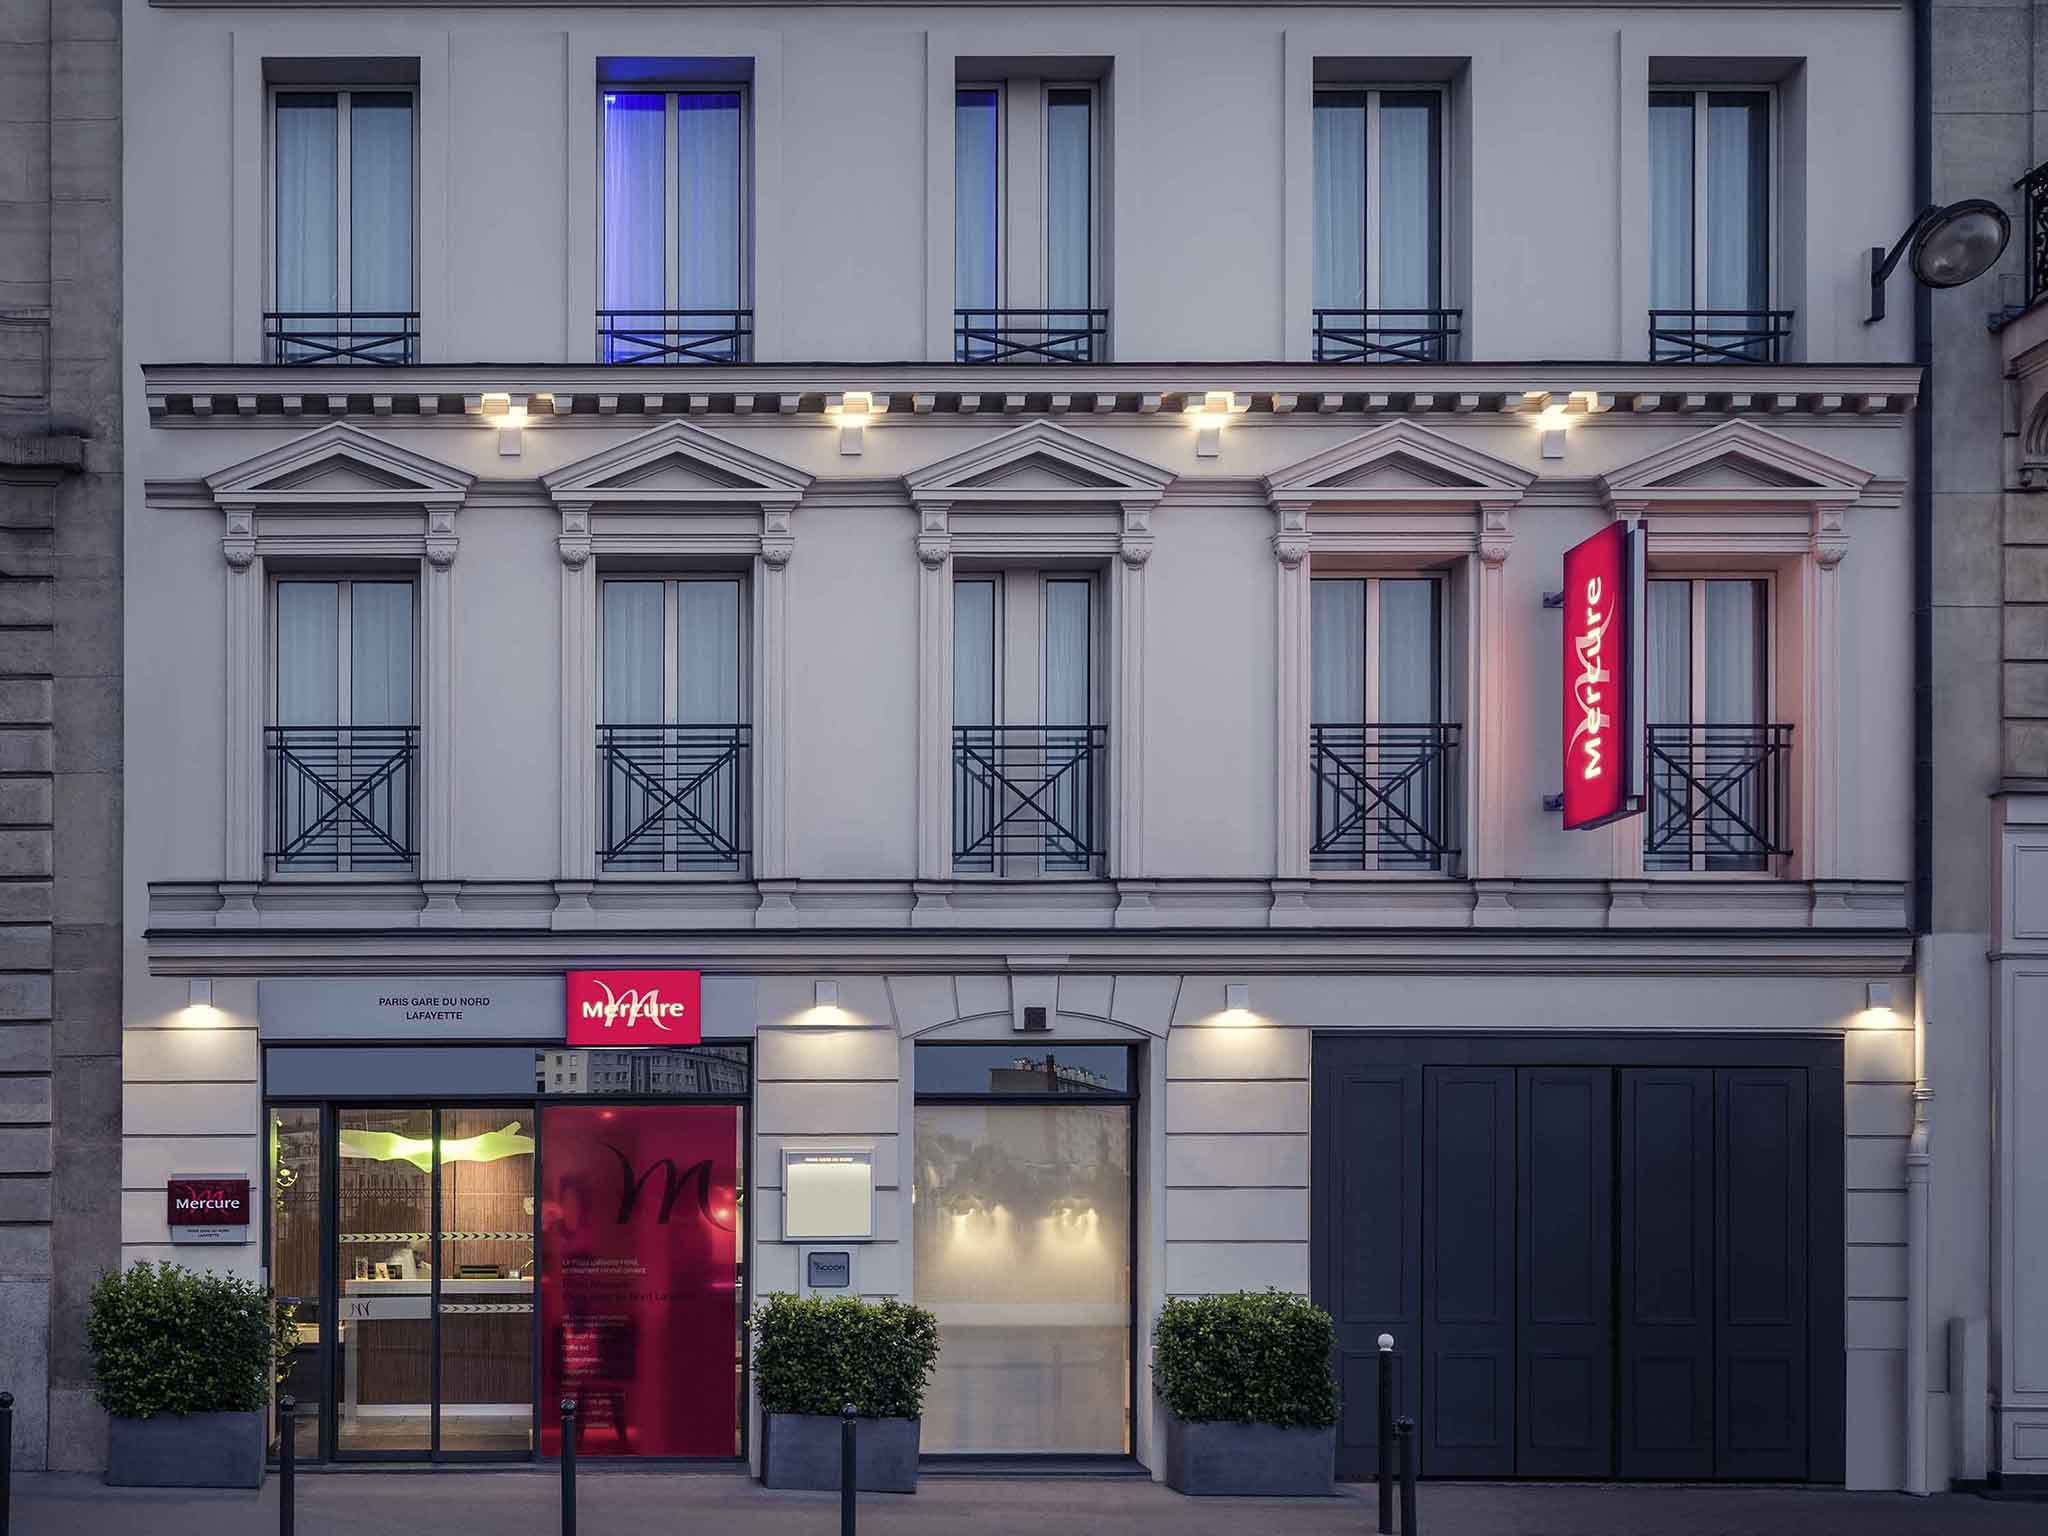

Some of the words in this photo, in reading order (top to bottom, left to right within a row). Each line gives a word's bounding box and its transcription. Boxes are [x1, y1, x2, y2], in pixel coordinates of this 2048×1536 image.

[1583, 576, 1602, 780] Mercure
[379, 997, 409, 1007] PARIS
[411, 997, 440, 1007] GARE
[442, 997, 457, 1007] DU
[460, 997, 490, 1007] NORD
[406, 1011, 463, 1020] LAFAYETTE
[582, 1001, 685, 1019] Mercure
[176, 1198, 240, 1209] Mercure
